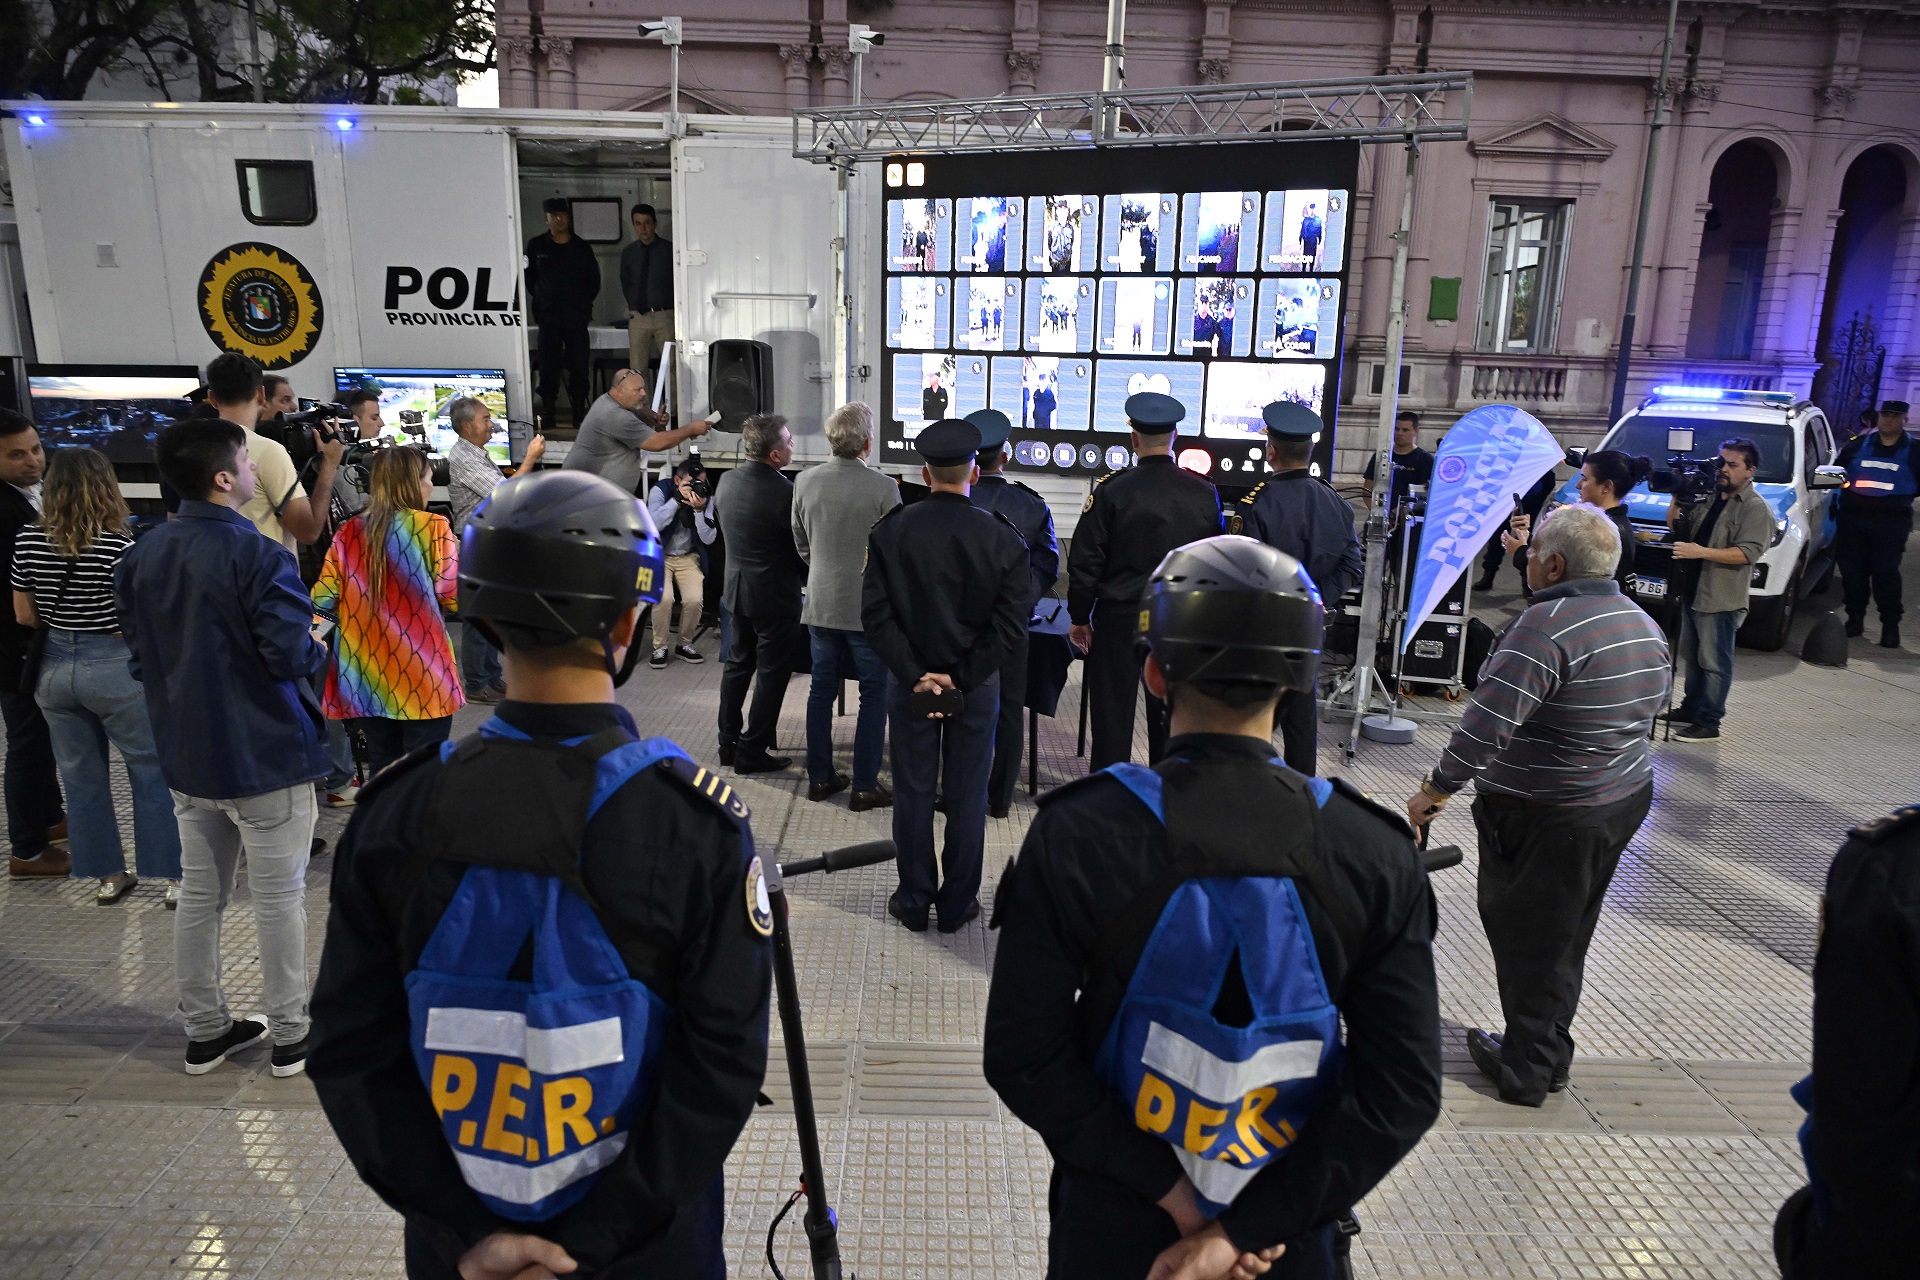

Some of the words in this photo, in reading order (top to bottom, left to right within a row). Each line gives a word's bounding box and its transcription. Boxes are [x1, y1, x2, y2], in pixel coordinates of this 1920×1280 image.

[386, 312, 497, 326] PROVINCIA
[350, 426, 360, 439] 7
[430, 1053, 616, 1162] P.E.R.
